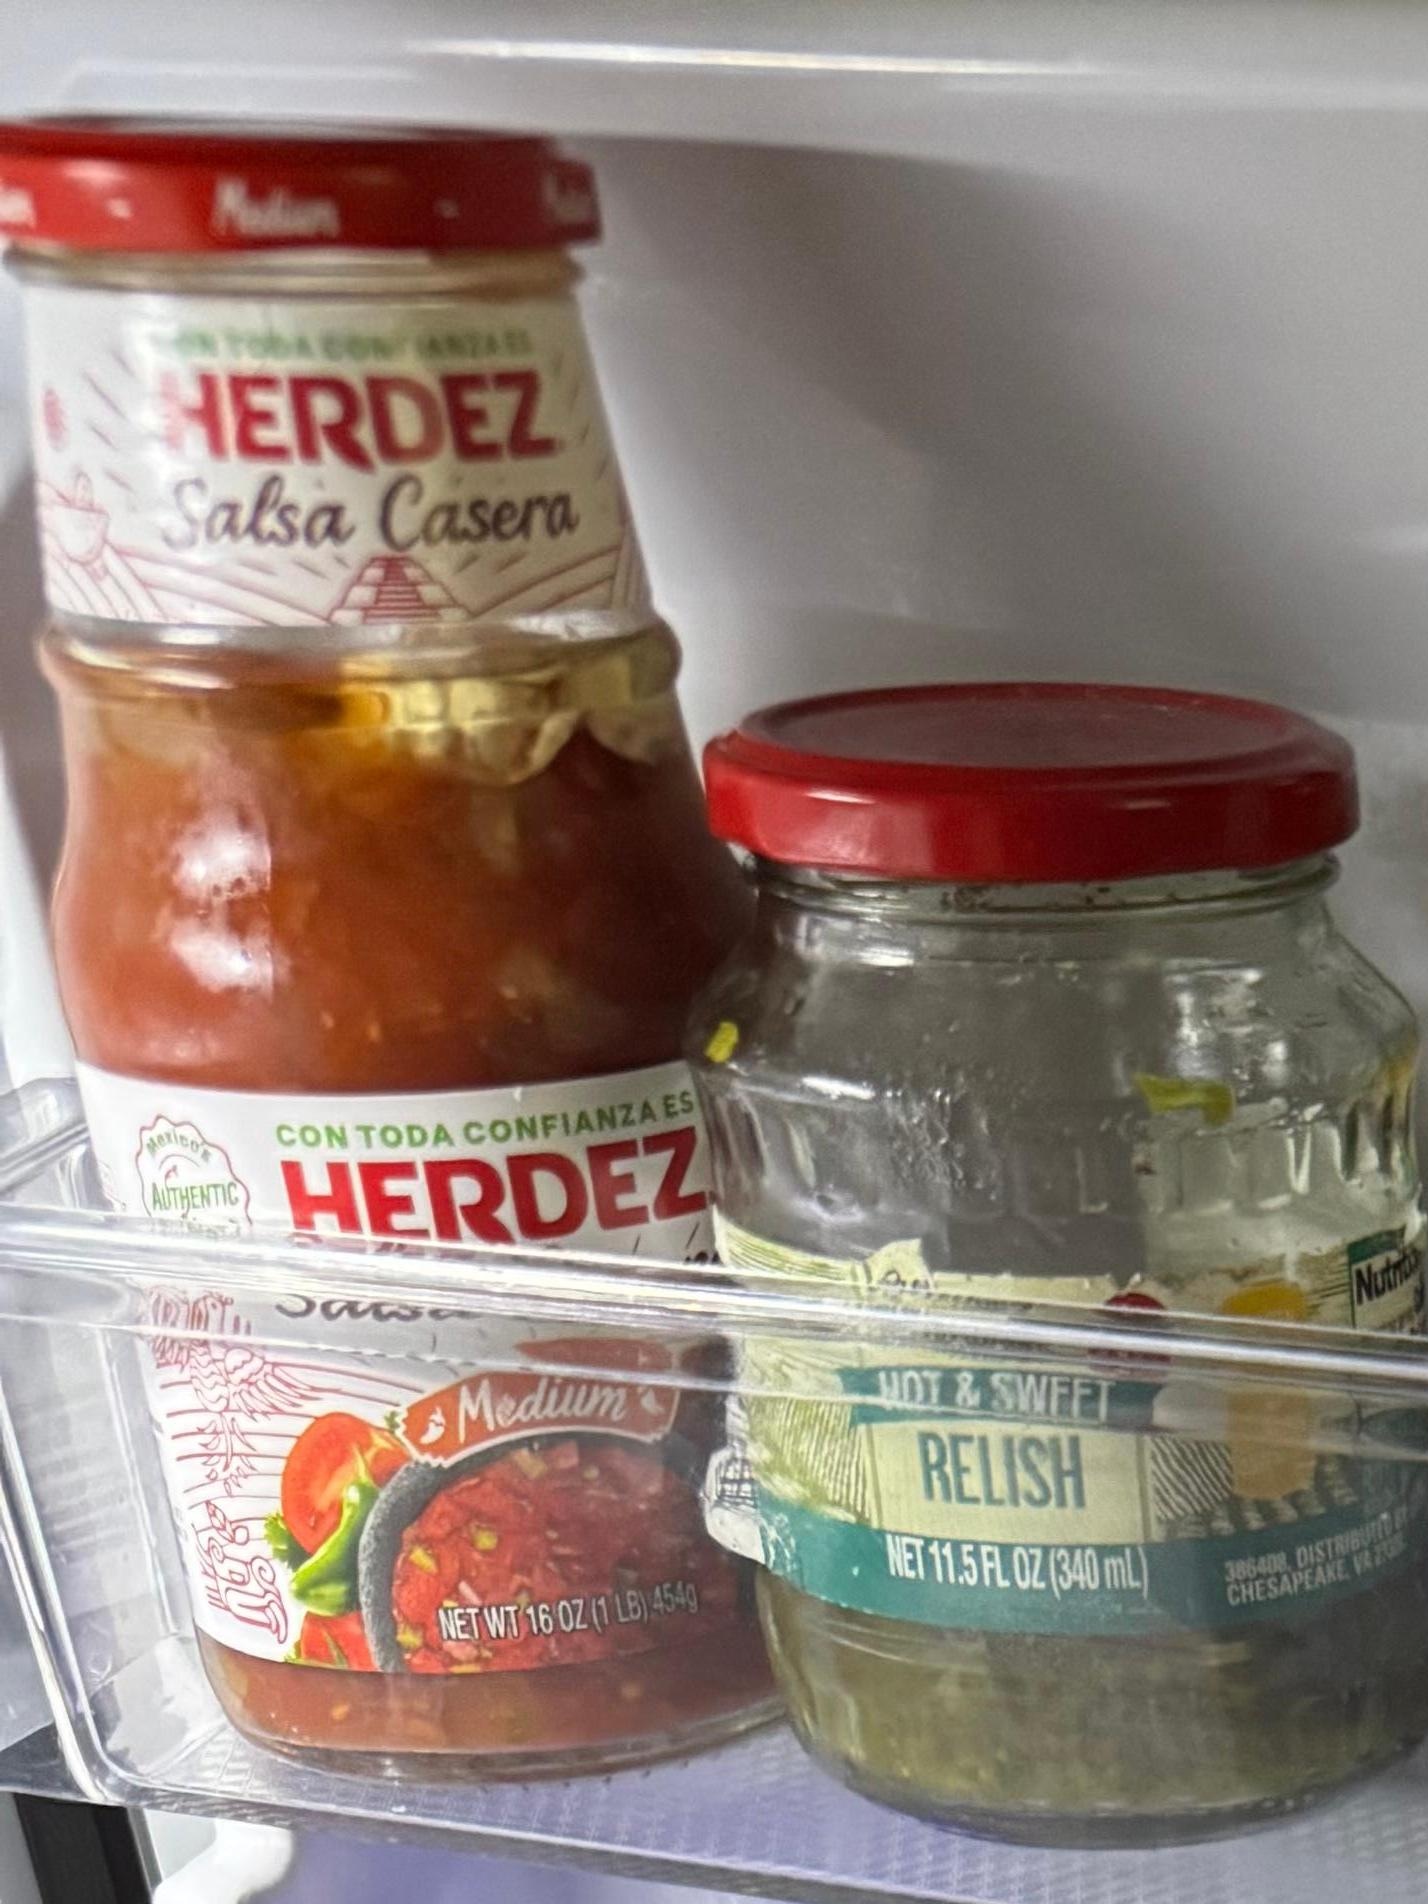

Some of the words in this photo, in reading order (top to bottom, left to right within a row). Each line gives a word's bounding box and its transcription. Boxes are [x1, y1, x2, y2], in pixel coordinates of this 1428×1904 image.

[159, 369, 560, 474] HERDEZ
[160, 473, 357, 551] Salsa
[378, 473, 581, 553] Casera
[275, 1122, 350, 1150] CON
[362, 1122, 455, 1149] TODA
[463, 1099, 657, 1147] CONFIANZA
[662, 1089, 696, 1117] ES
[151, 1180, 240, 1212] AUTHENTIC
[280, 1124, 712, 1246] HERDEZ
[455, 1372, 633, 1446] Medium
[877, 1370, 943, 1410] HOT
[917, 1431, 1088, 1511] RELISH
[884, 1532, 926, 1580] NET
[927, 1540, 978, 1586] 11.5
[980, 1543, 1011, 1590] FL
[1012, 1546, 1047, 1592] OZ
[1048, 1546, 1102, 1600] (340
[1103, 1545, 1152, 1600] mL)
[437, 1606, 479, 1643] NET
[483, 1605, 521, 1641] WT
[526, 1604, 554, 1637] 16
[557, 1597, 588, 1633] OZ
[590, 1597, 611, 1637] (1
[614, 1590, 648, 1628] LB)
[651, 1582, 699, 1620] 454g
